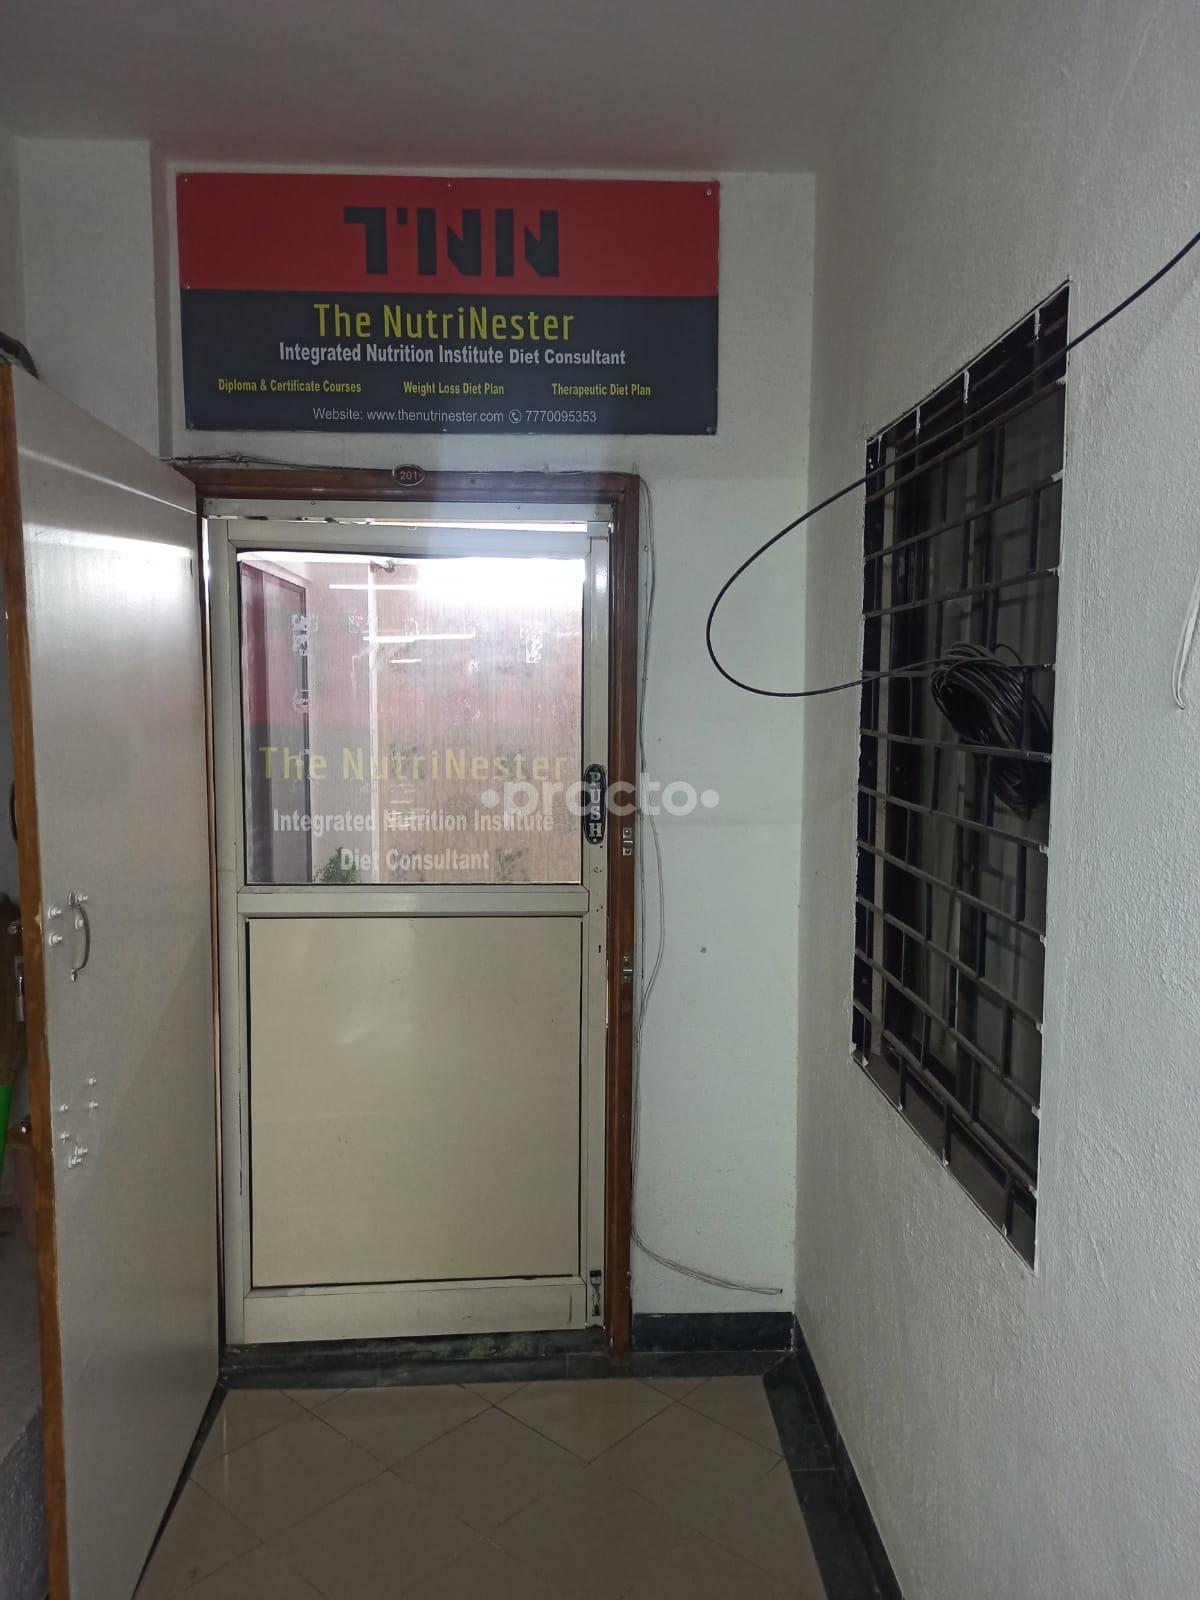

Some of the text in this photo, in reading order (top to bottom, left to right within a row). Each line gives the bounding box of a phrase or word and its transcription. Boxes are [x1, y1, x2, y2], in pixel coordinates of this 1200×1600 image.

[314, 303, 575, 341] The NutriNester
[279, 342, 626, 365] Integrated Nutrition Institute Diet Consultant
[218, 378, 362, 393] Diploma & Certificate Courses
[403, 381, 505, 396] Weight Loss Diet Plan
[552, 383, 651, 397] Therapeutic Diet Plan
[313, 408, 597, 423] Website: www.thenutrinester.com 7770095353
[400, 470, 418, 480] 201
[258, 747, 568, 781] The NutriNester
[588, 771, 603, 838] PUSH
[273, 809, 554, 838] Integrated Nutrition Institute
[340, 849, 490, 872] Diet Consultant
